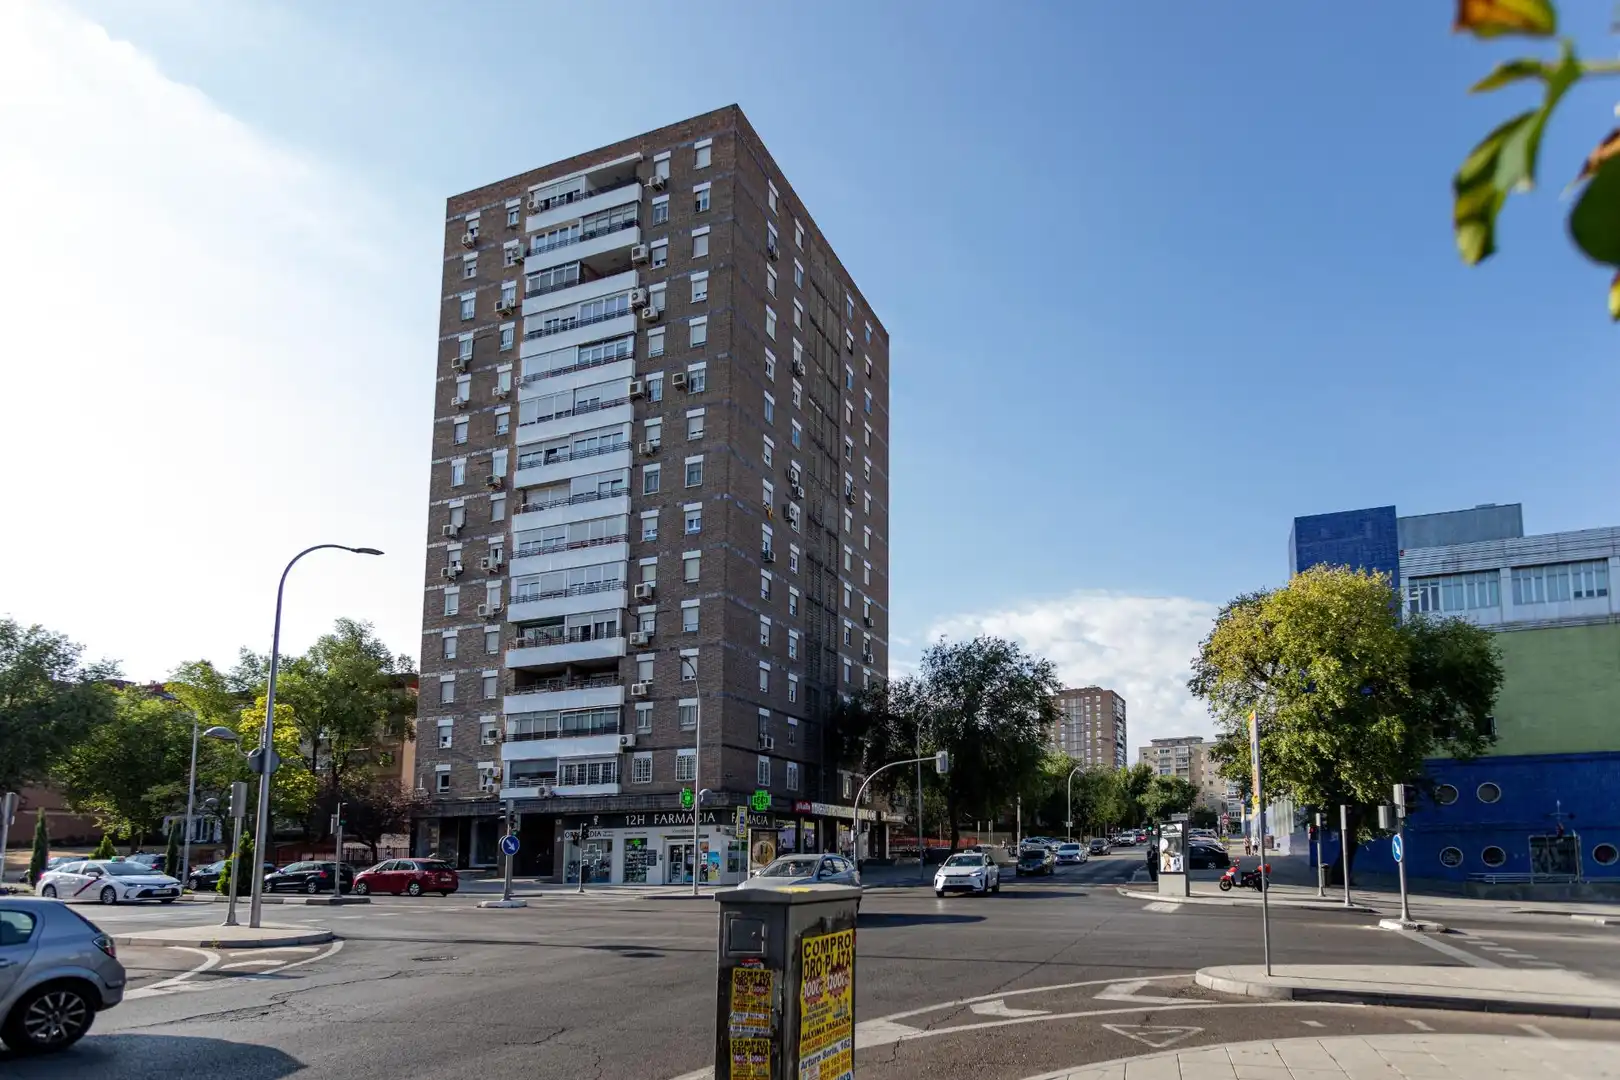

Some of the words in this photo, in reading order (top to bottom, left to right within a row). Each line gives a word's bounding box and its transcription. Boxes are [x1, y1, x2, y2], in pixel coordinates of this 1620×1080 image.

[625, 814, 645, 826] 12H
[654, 812, 716, 825] FARMACIA
[804, 933, 851, 958] COMPRO
[735, 970, 771, 980] COMPRO
[801, 1055, 821, 1071] Arturo
